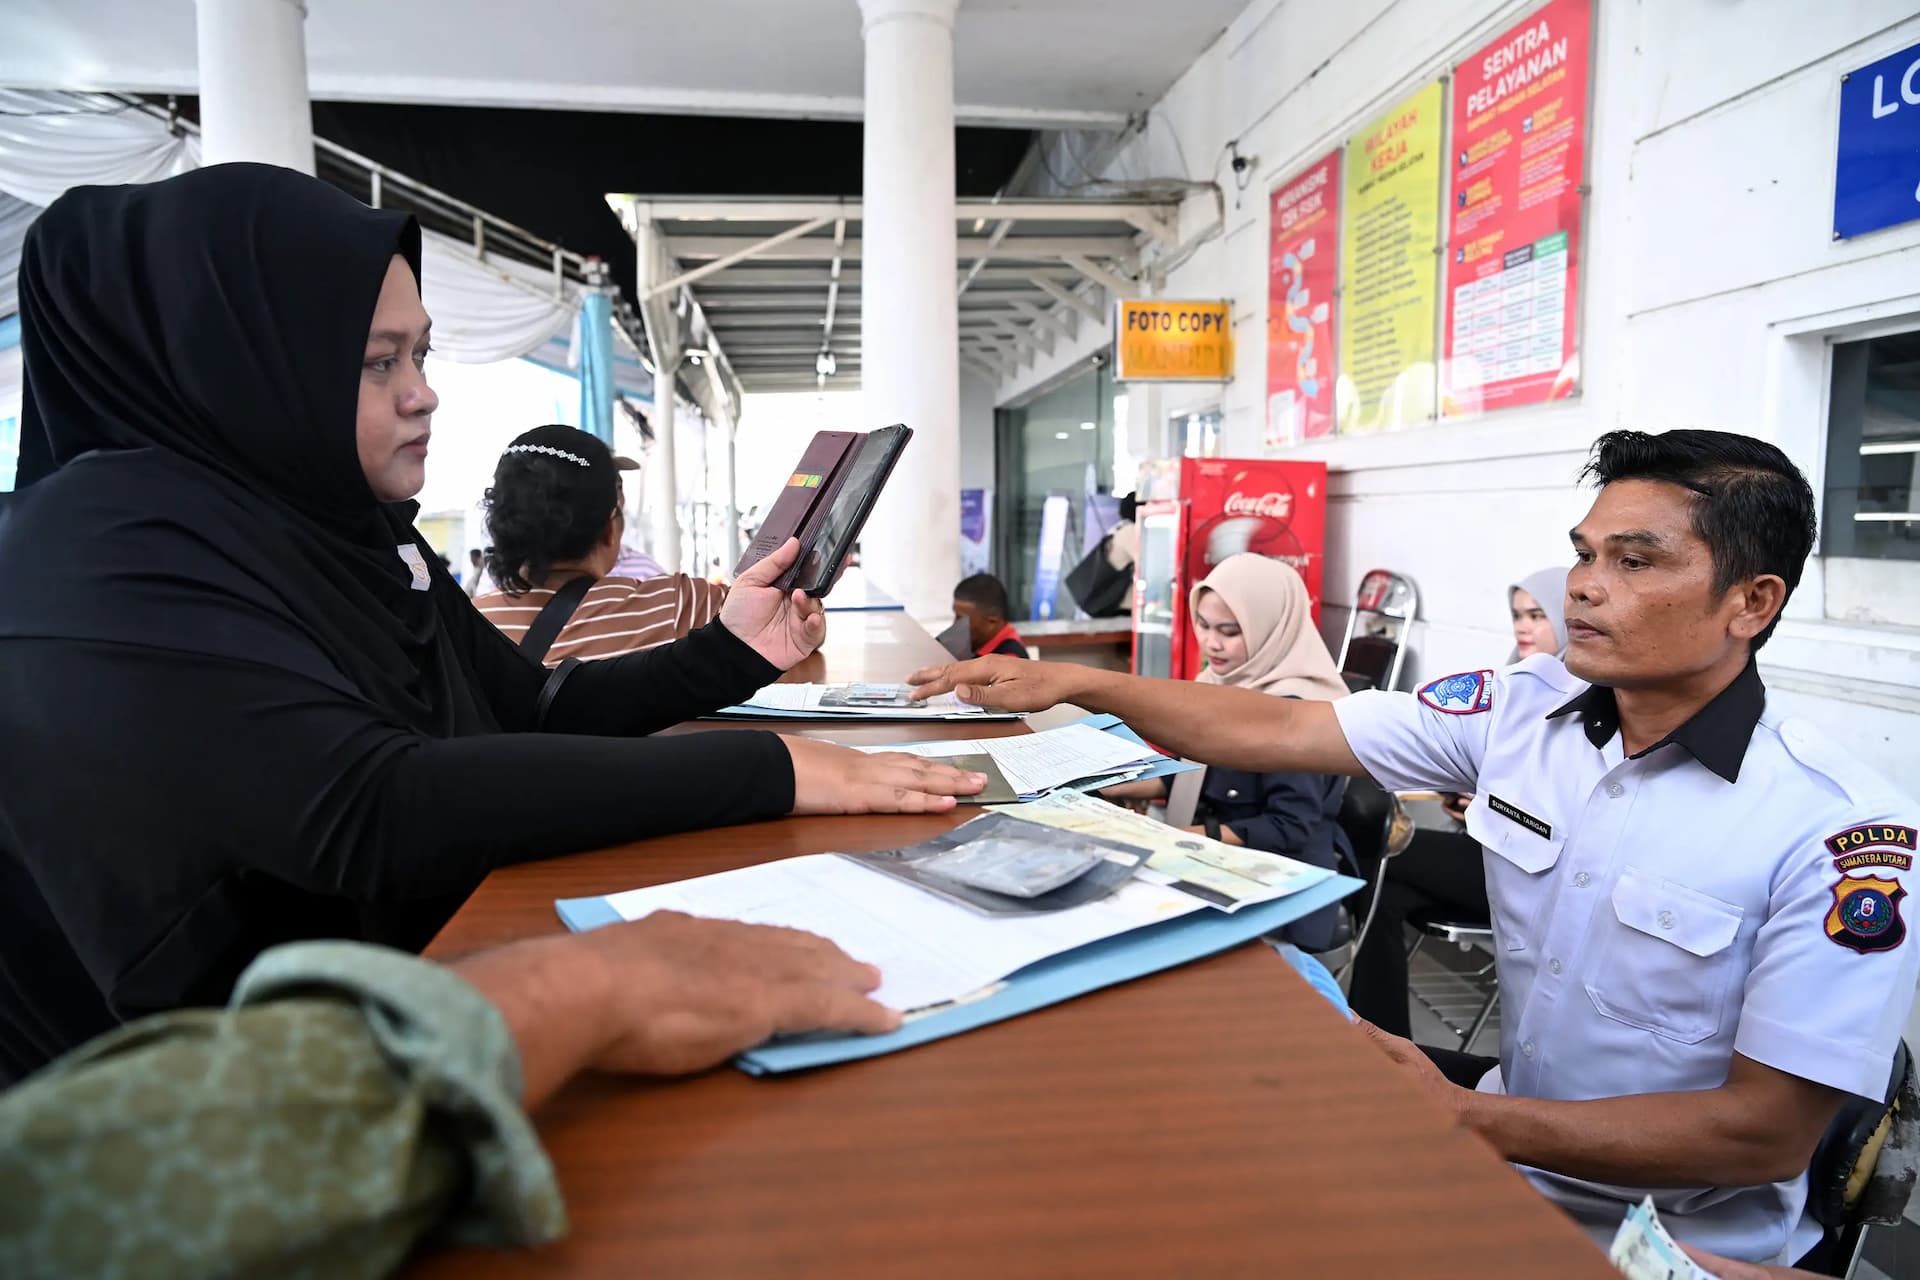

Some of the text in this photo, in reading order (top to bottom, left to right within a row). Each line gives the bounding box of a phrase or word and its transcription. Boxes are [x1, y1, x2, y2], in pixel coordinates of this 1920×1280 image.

[1482, 20, 1549, 81] SENTRA
[1466, 37, 1568, 118] PELAYANAN
[1370, 139, 1408, 172] KERJA
[1128, 311, 1224, 333] FOTO COPY
[1836, 828, 1908, 851] POLDA
[1840, 854, 1907, 868] SUMATERA UTARA
